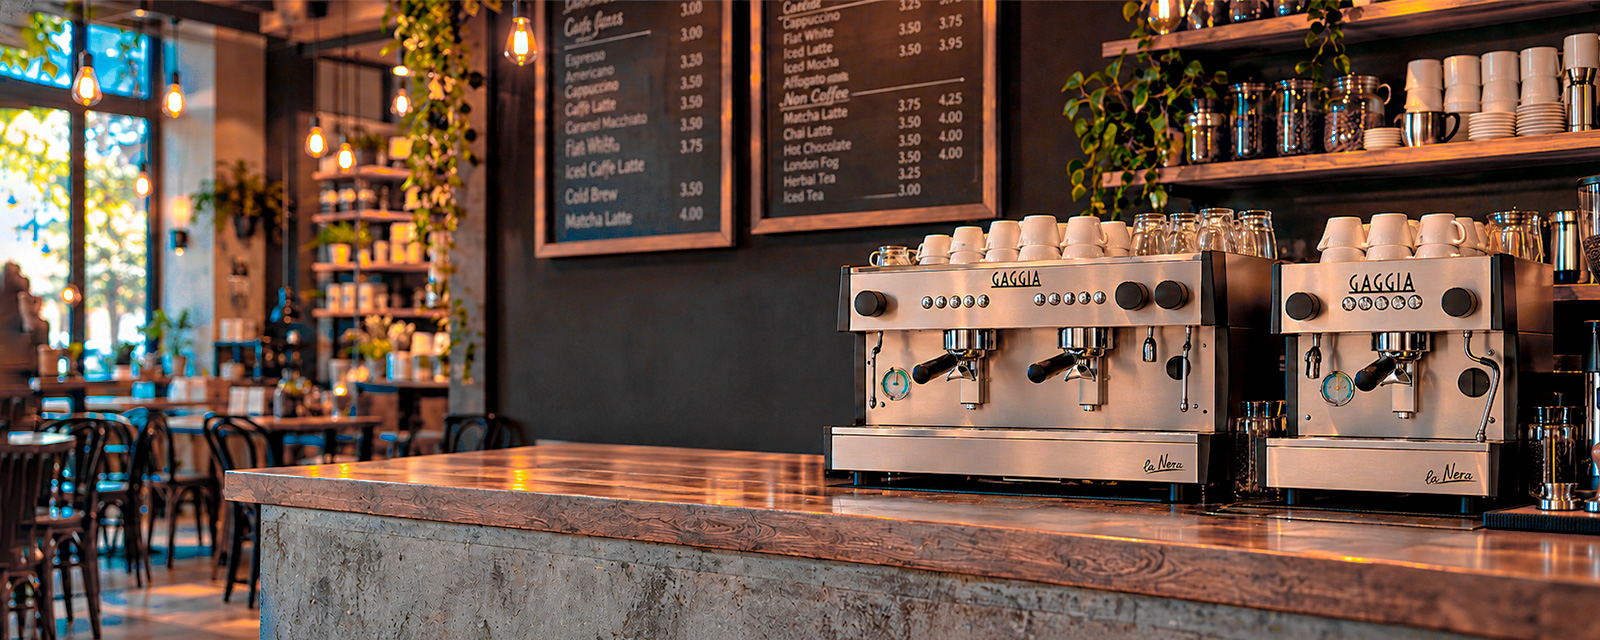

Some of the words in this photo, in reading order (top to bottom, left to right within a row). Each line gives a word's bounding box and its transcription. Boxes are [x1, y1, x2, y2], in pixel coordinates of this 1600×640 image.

[680, 1, 703, 17] 3.00
[899, 0, 921, 11] 3.25
[783, 11, 841, 30] Cappuccino
[899, 21, 922, 36] 3.50
[939, 14, 963, 30] 3.75
[680, 25, 703, 42] 3.00
[783, 32, 803, 45] Flat
[805, 27, 834, 42] White
[783, 46, 805, 60] Iced
[807, 42, 833, 56] Latte
[899, 42, 922, 57] 3.50
[939, 36, 963, 51] 3.95
[565, 50, 606, 68] Espresso
[784, 61, 805, 75] Iced
[807, 56, 840, 71] Mocha
[564, 65, 615, 83] Americano
[680, 74, 703, 90] 3.50
[783, 74, 826, 90] Affogato
[565, 80, 619, 99] Cappuccino
[783, 91, 808, 106] Non
[811, 85, 849, 105] Coffee
[592, 98, 617, 113] Latte
[680, 94, 703, 110] 3.50
[898, 97, 921, 112] 3.75
[565, 117, 601, 134] Caramel
[602, 113, 648, 129] Macchiato
[680, 116, 703, 132] 3.50
[783, 110, 820, 125] Matcha
[821, 107, 848, 122] Latte
[898, 115, 921, 129] 3.50
[939, 110, 963, 125] 4.00
[783, 126, 804, 141] Chai
[806, 124, 833, 138] Latte
[898, 133, 921, 147] 3.50
[939, 129, 963, 143] 4.00
[680, 138, 703, 154] 3.75
[784, 142, 801, 156] Hot
[803, 139, 852, 155] Chocolate
[939, 146, 963, 160] 4.00
[784, 157, 819, 172] London
[820, 156, 839, 170] Fog
[898, 151, 921, 165] 3.50
[565, 161, 587, 179] Iced
[617, 158, 645, 174] Latte
[898, 166, 921, 180] 3.25
[784, 173, 817, 188] Herbal
[818, 172, 836, 184] Tea
[565, 187, 589, 205] Cold
[591, 186, 618, 202] Brew
[680, 181, 703, 197] 3.50
[784, 190, 805, 204] Iced
[806, 187, 824, 201] Tea
[898, 183, 921, 197] 3.00
[565, 211, 603, 229] Matcha
[604, 210, 633, 226] Latte
[679, 206, 703, 221] 4.00
[991, 270, 1041, 288] GAGGIA
[1348, 272, 1415, 294] GAGGIA
[1157, 453, 1184, 470] Nera
[1442, 462, 1473, 482] Nera
